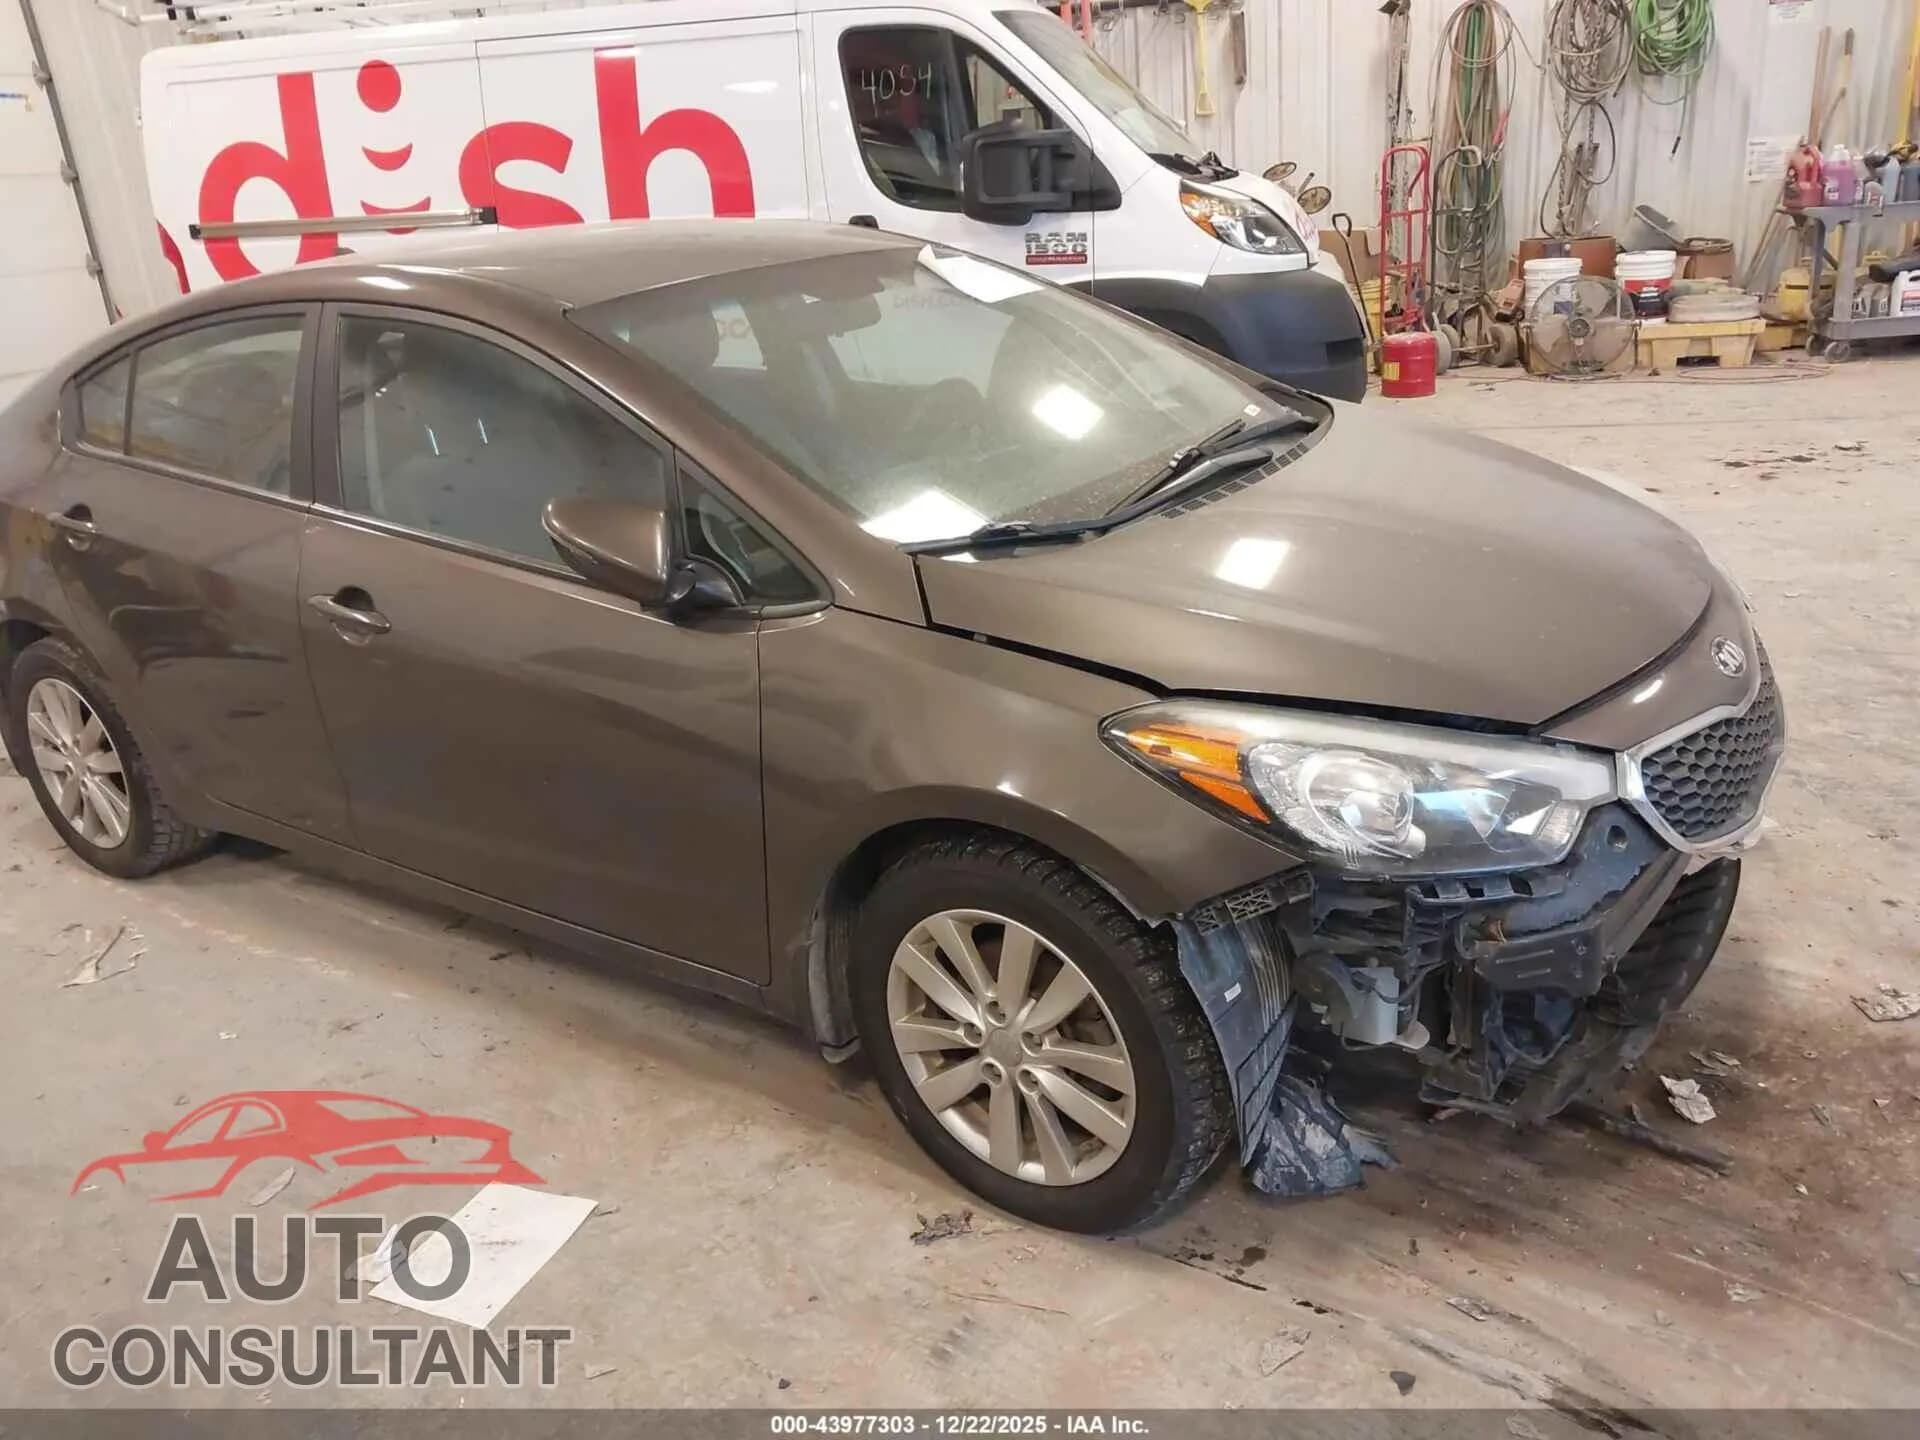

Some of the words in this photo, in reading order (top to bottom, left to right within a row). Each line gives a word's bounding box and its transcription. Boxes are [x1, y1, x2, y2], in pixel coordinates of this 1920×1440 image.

[861, 62, 932, 105] 4054
[198, 46, 756, 283] dish
[1025, 232, 1088, 243] RAM
[1026, 243, 1088, 254] 1500
